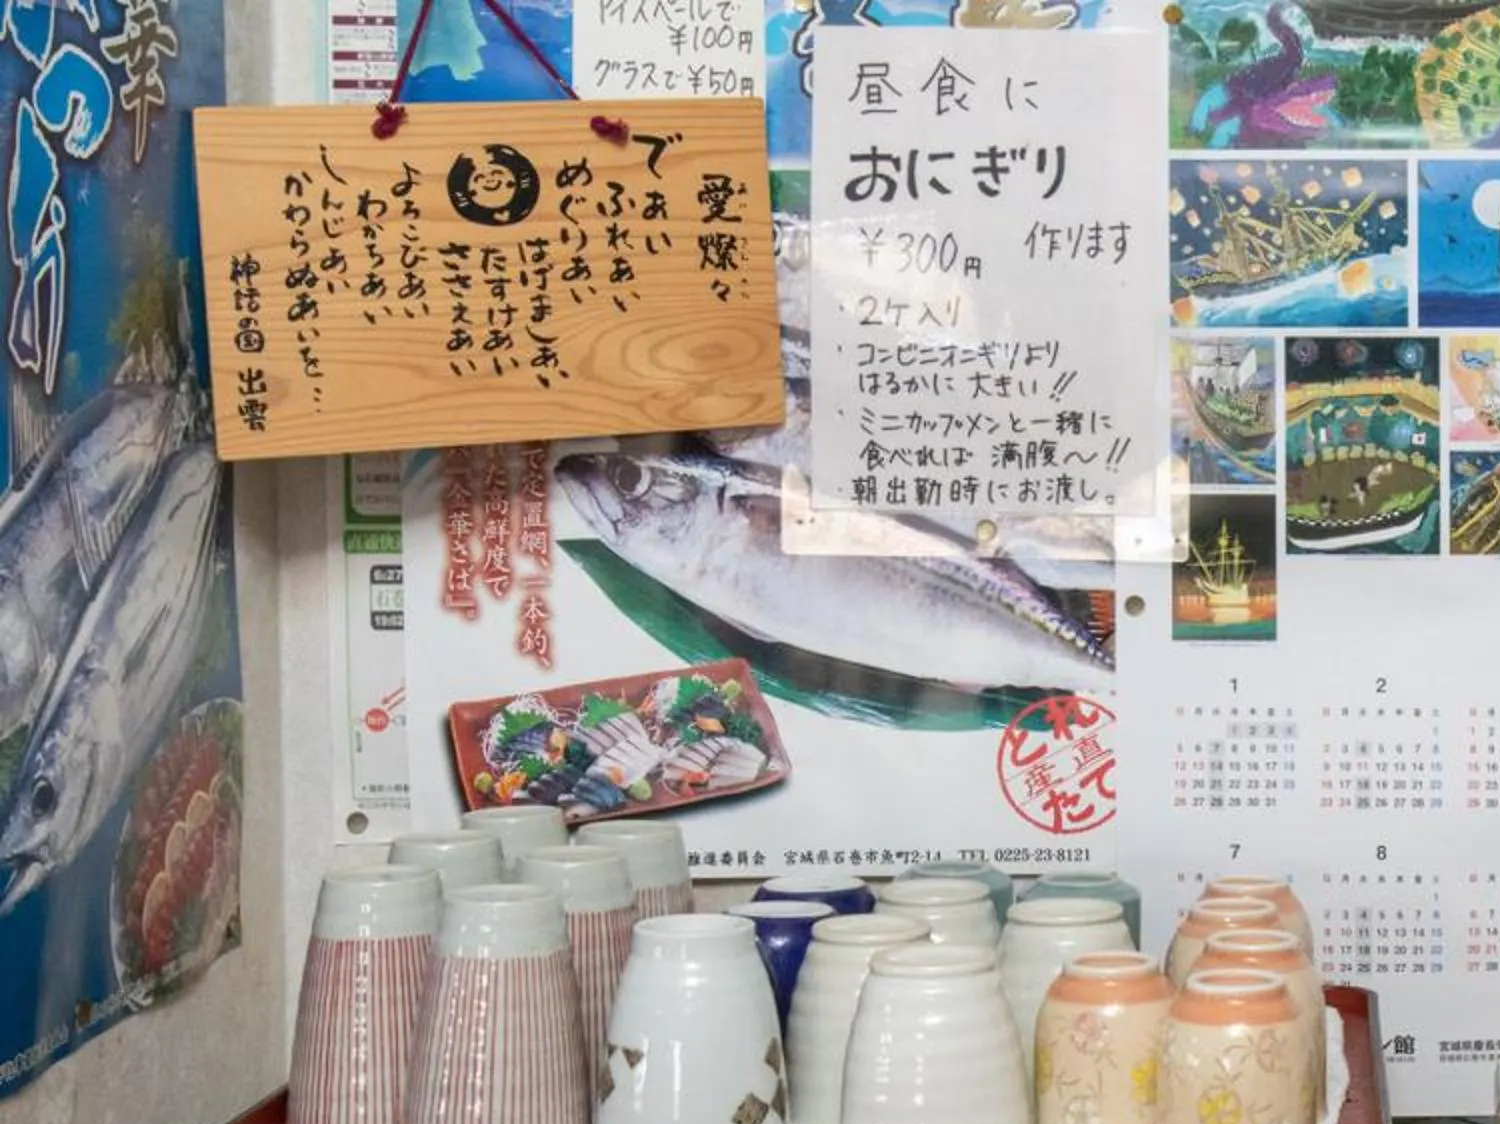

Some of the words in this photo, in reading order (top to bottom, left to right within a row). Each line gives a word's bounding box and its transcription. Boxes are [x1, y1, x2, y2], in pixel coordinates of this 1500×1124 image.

[848, 57, 1040, 115] 昼食に
[319, 143, 351, 295] しんじあい
[555, 156, 598, 306] めぐりあい
[631, 132, 684, 255] であい
[843, 145, 1068, 201] おにぎり
[356, 187, 393, 326] わかちあい
[389, 160, 431, 320] よろこびあい
[596, 181, 641, 313] ふれあい
[1024, 220, 1133, 265] 作ります
[437, 241, 478, 378] ささえあい
[479, 246, 520, 377] たすけあい
[518, 237, 571, 389] はげましあい
[858, 370, 956, 396] はるかに
[858, 439, 975, 471] 食べれば
[1229, 677, 1239, 694] 1
[1375, 677, 1388, 694] 2
[994, 847, 1091, 864] 0225-23-8121
[1229, 844, 1241, 860] 7
[1375, 845, 1388, 861] 8
